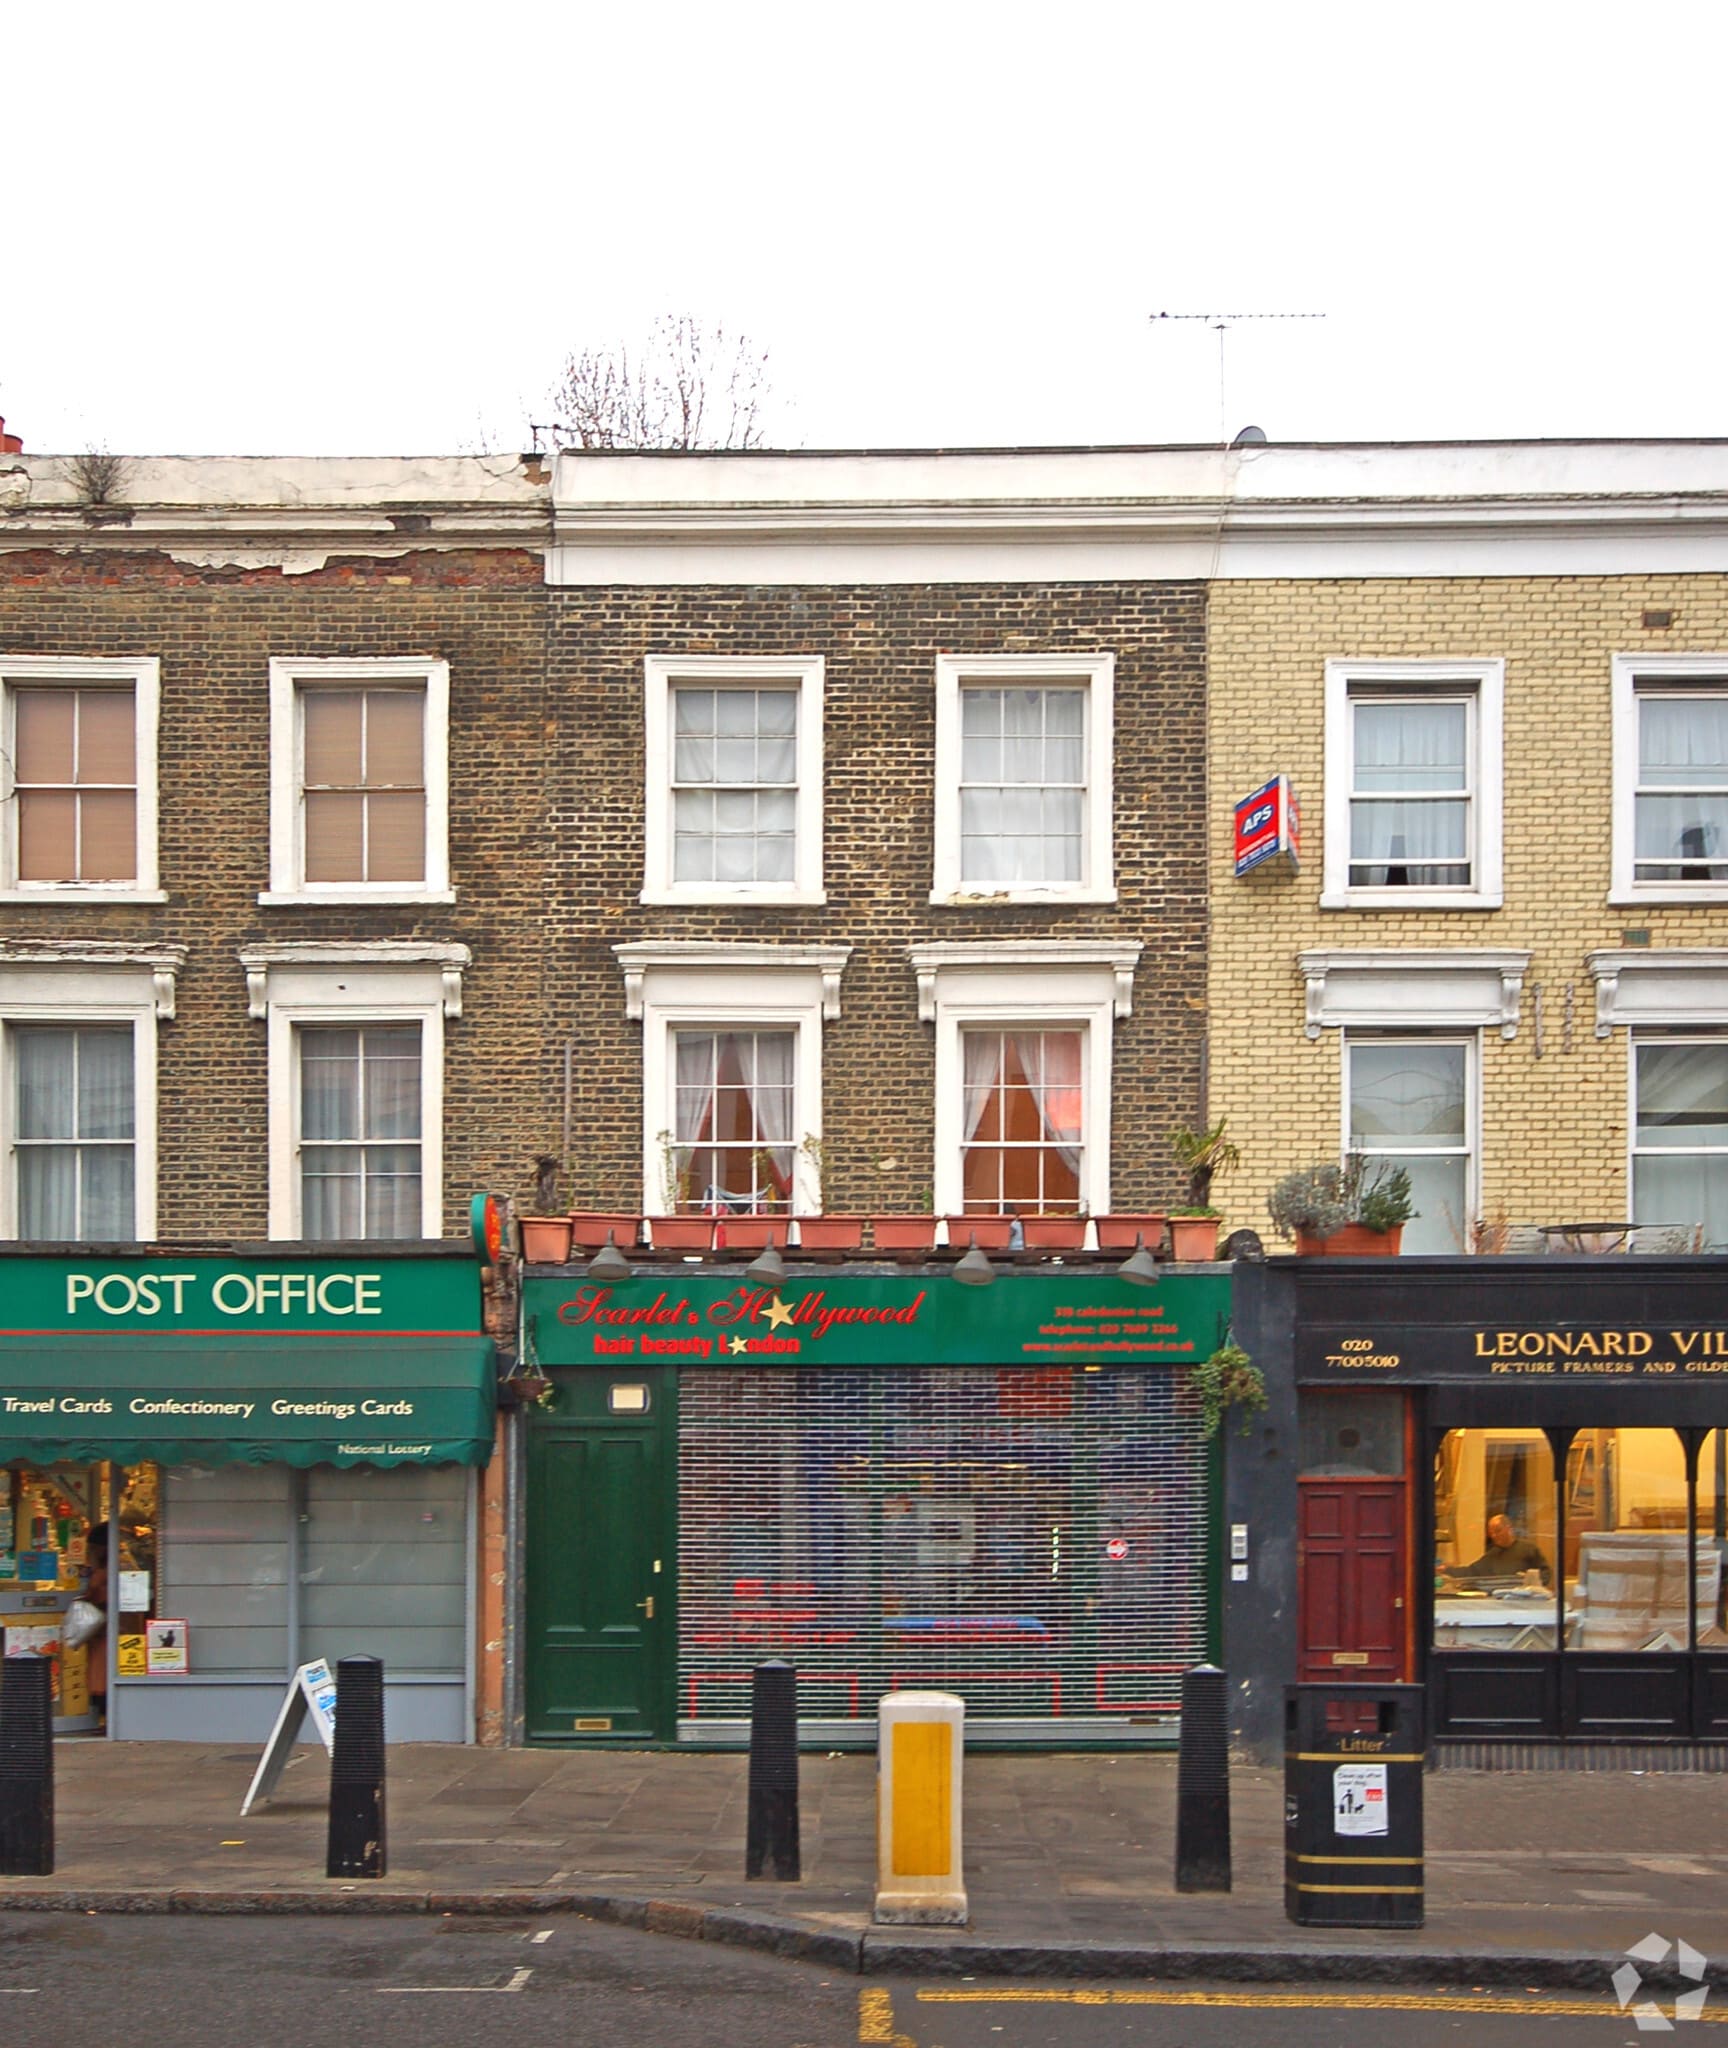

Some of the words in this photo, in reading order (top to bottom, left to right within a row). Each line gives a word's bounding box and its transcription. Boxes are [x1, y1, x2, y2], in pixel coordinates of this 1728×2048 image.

[1242, 804, 1273, 835] APS
[66, 1274, 197, 1315] POST
[211, 1274, 382, 1315] OFFICE
[557, 1285, 690, 1326] Scarlet
[706, 1286, 928, 1340] Hllywood
[593, 1333, 636, 1355] hair
[639, 1333, 714, 1360] beauty
[717, 1333, 802, 1355] Lndon
[1341, 1339, 1374, 1352] 020
[1475, 1331, 1654, 1356] LEONARD
[1491, 1362, 1556, 1374] PICTURE
[1563, 1361, 1635, 1374] FRAMERS
[1643, 1361, 1677, 1374] AND
[3, 1398, 55, 1413] Travel
[59, 1398, 113, 1414] Cards
[129, 1398, 256, 1419] Confectionery
[271, 1399, 356, 1420] Greetings
[360, 1400, 414, 1416] Cards
[337, 1443, 386, 1455] National
[388, 1444, 433, 1456] Lottery
[1341, 1738, 1384, 1752] Litter
